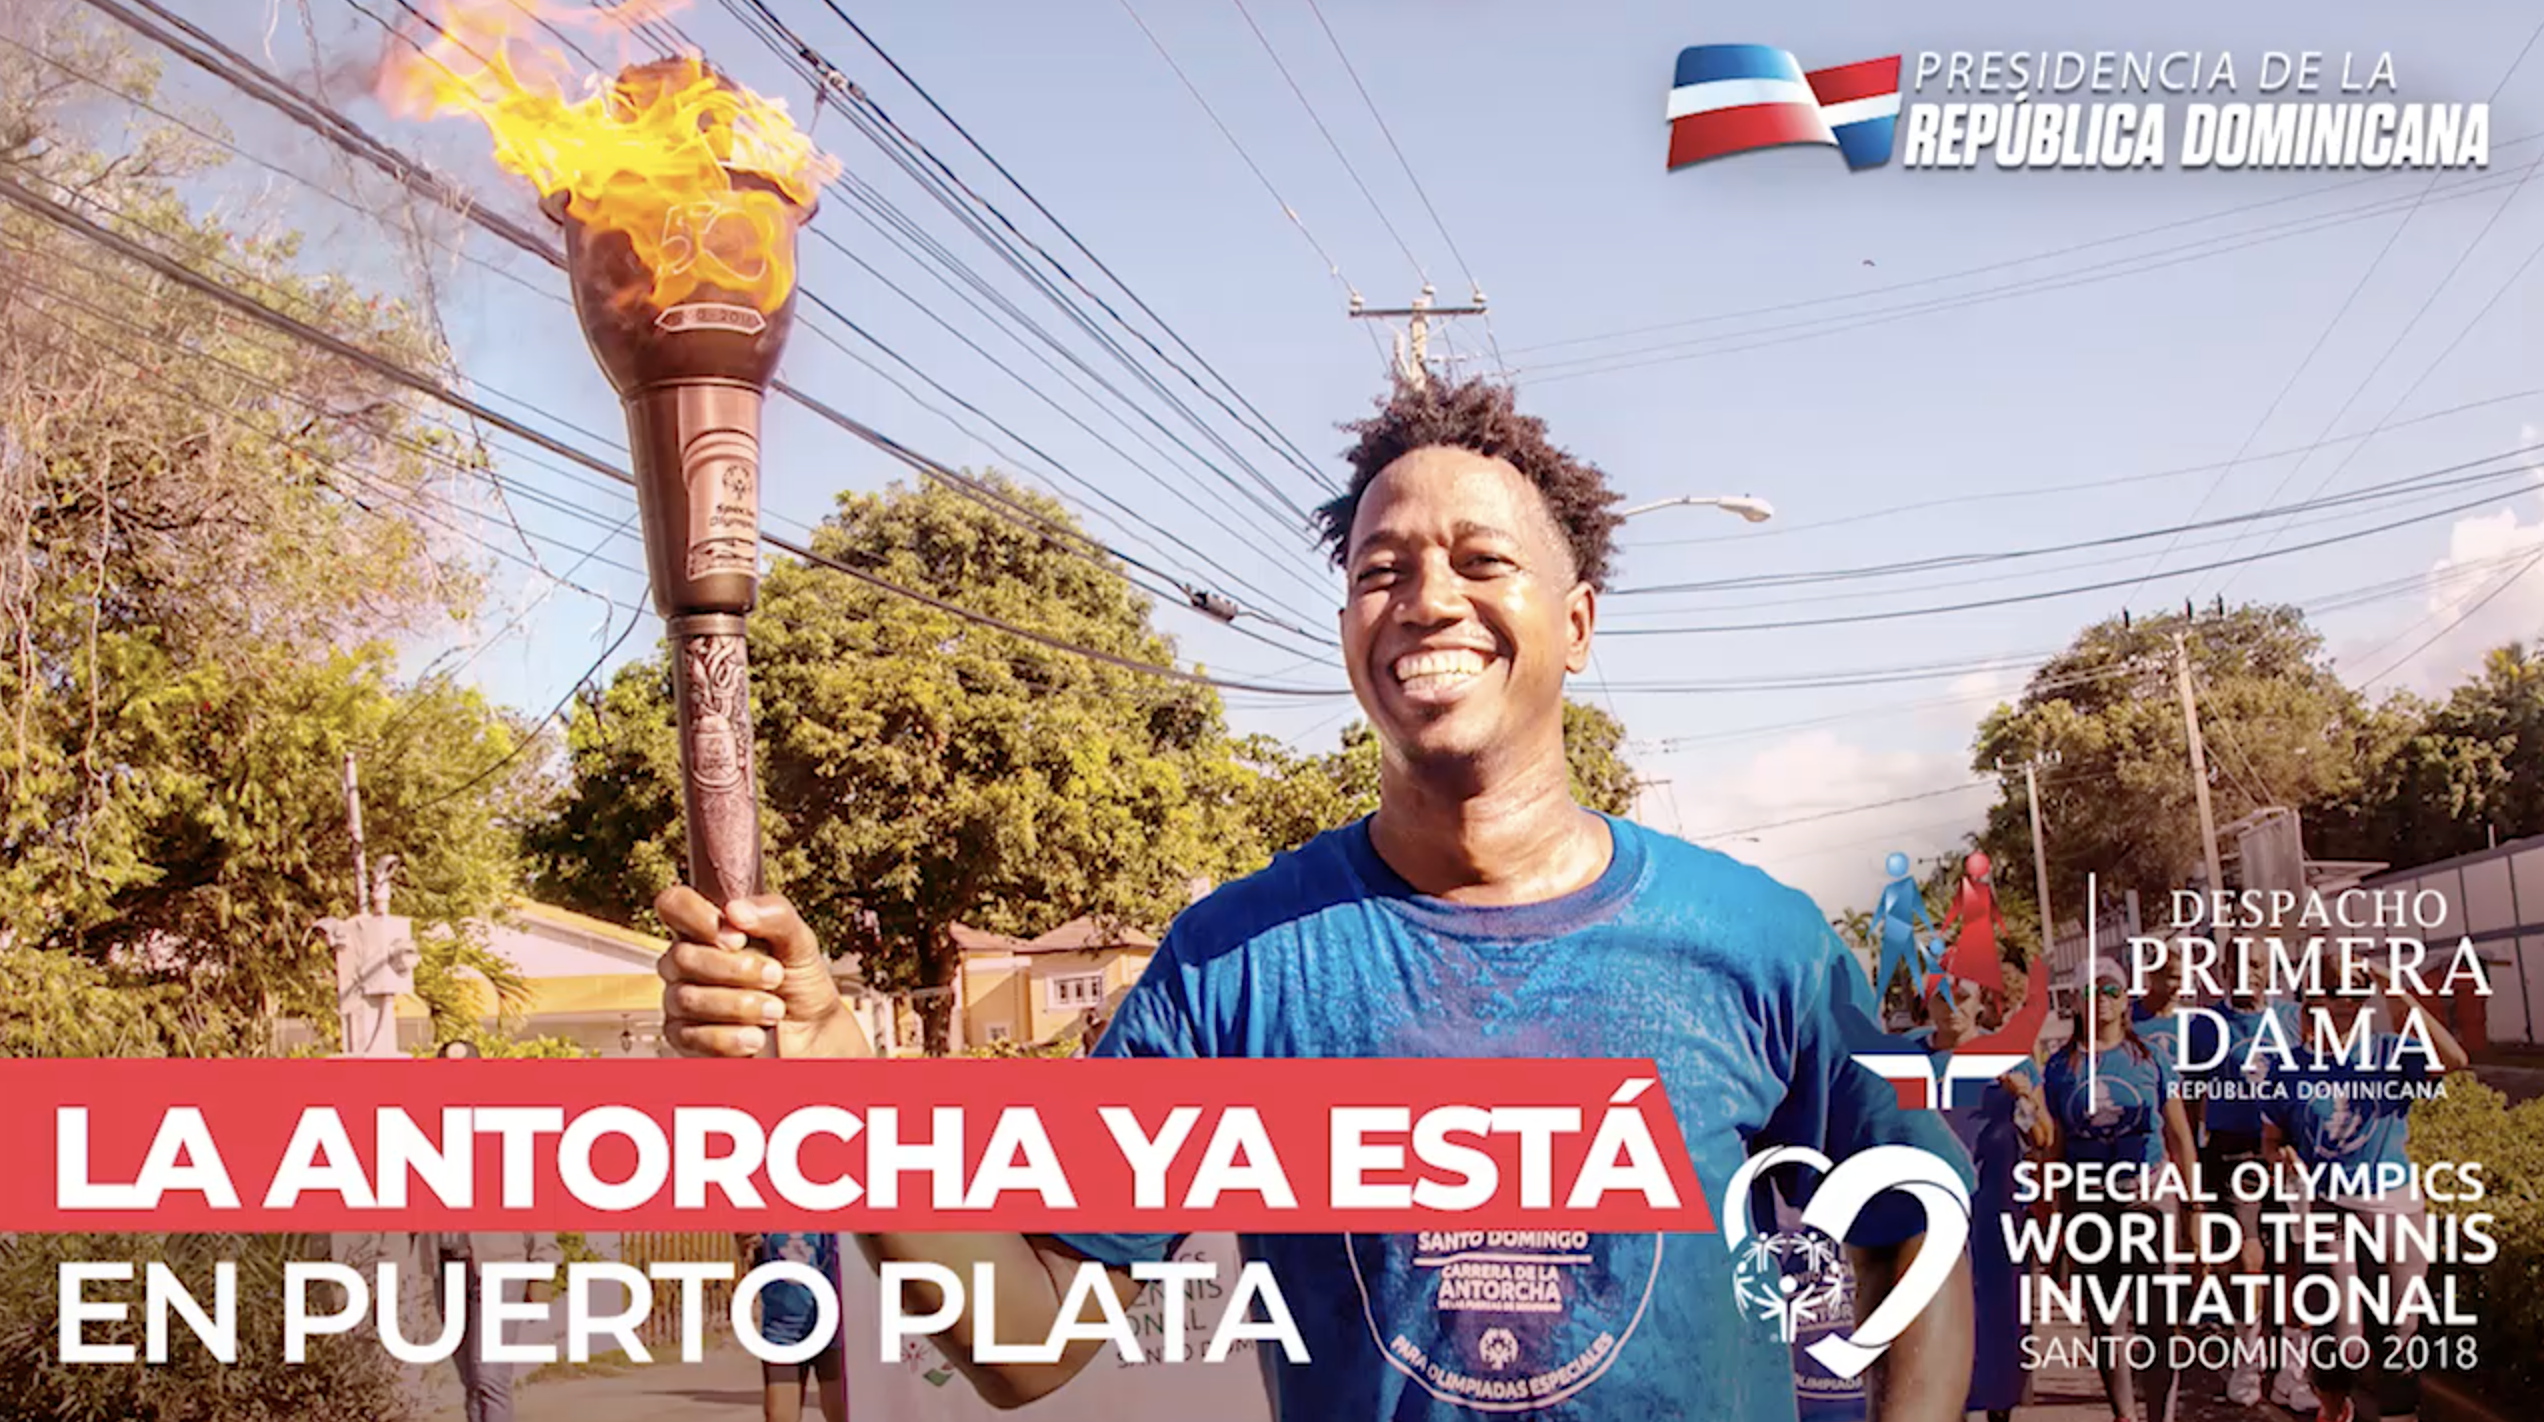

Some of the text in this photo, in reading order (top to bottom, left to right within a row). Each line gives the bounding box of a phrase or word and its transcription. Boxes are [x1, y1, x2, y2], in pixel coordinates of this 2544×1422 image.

[1418, 1231, 1588, 1252] SANTO DOMINGO
[1441, 1264, 1512, 1280] CARRERA
[1438, 1279, 1561, 1301] ANTORCHA
[1389, 1331, 1615, 1400] PARA OLIMPIADAS ESPECIALES
